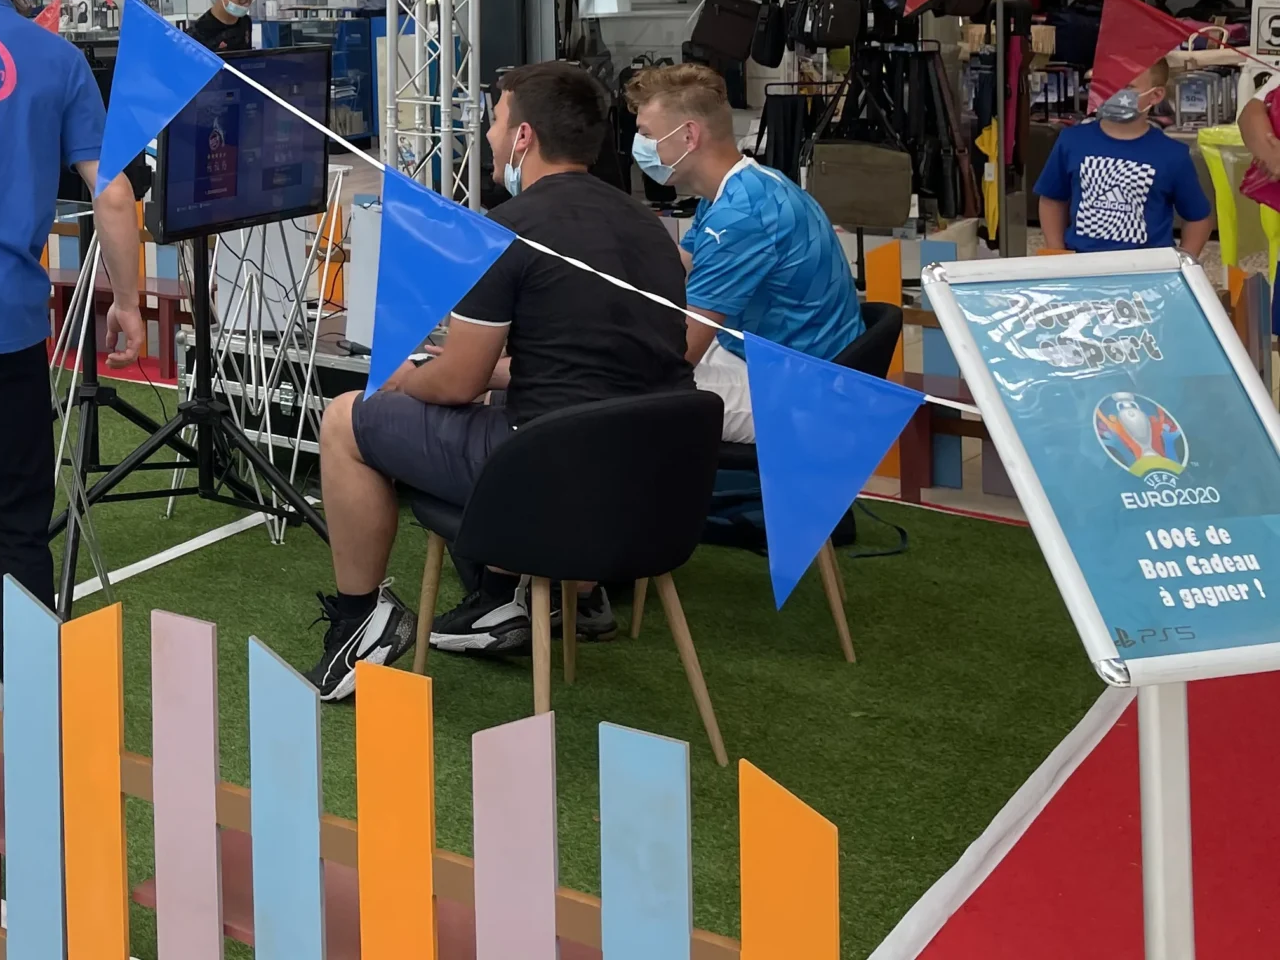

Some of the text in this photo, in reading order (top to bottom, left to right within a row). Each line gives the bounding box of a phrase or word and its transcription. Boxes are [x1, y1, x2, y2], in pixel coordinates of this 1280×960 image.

[1092, 200, 1132, 211] adidas
[1039, 329, 1164, 370] esport
[1146, 474, 1177, 488] UEFA
[1120, 486, 1220, 509] EURO2020
[1145, 525, 1232, 550] 100€ de
[1138, 553, 1261, 579] Bon Cadeau
[1159, 578, 1266, 609] à gagner !
[1137, 626, 1196, 643] PS5
